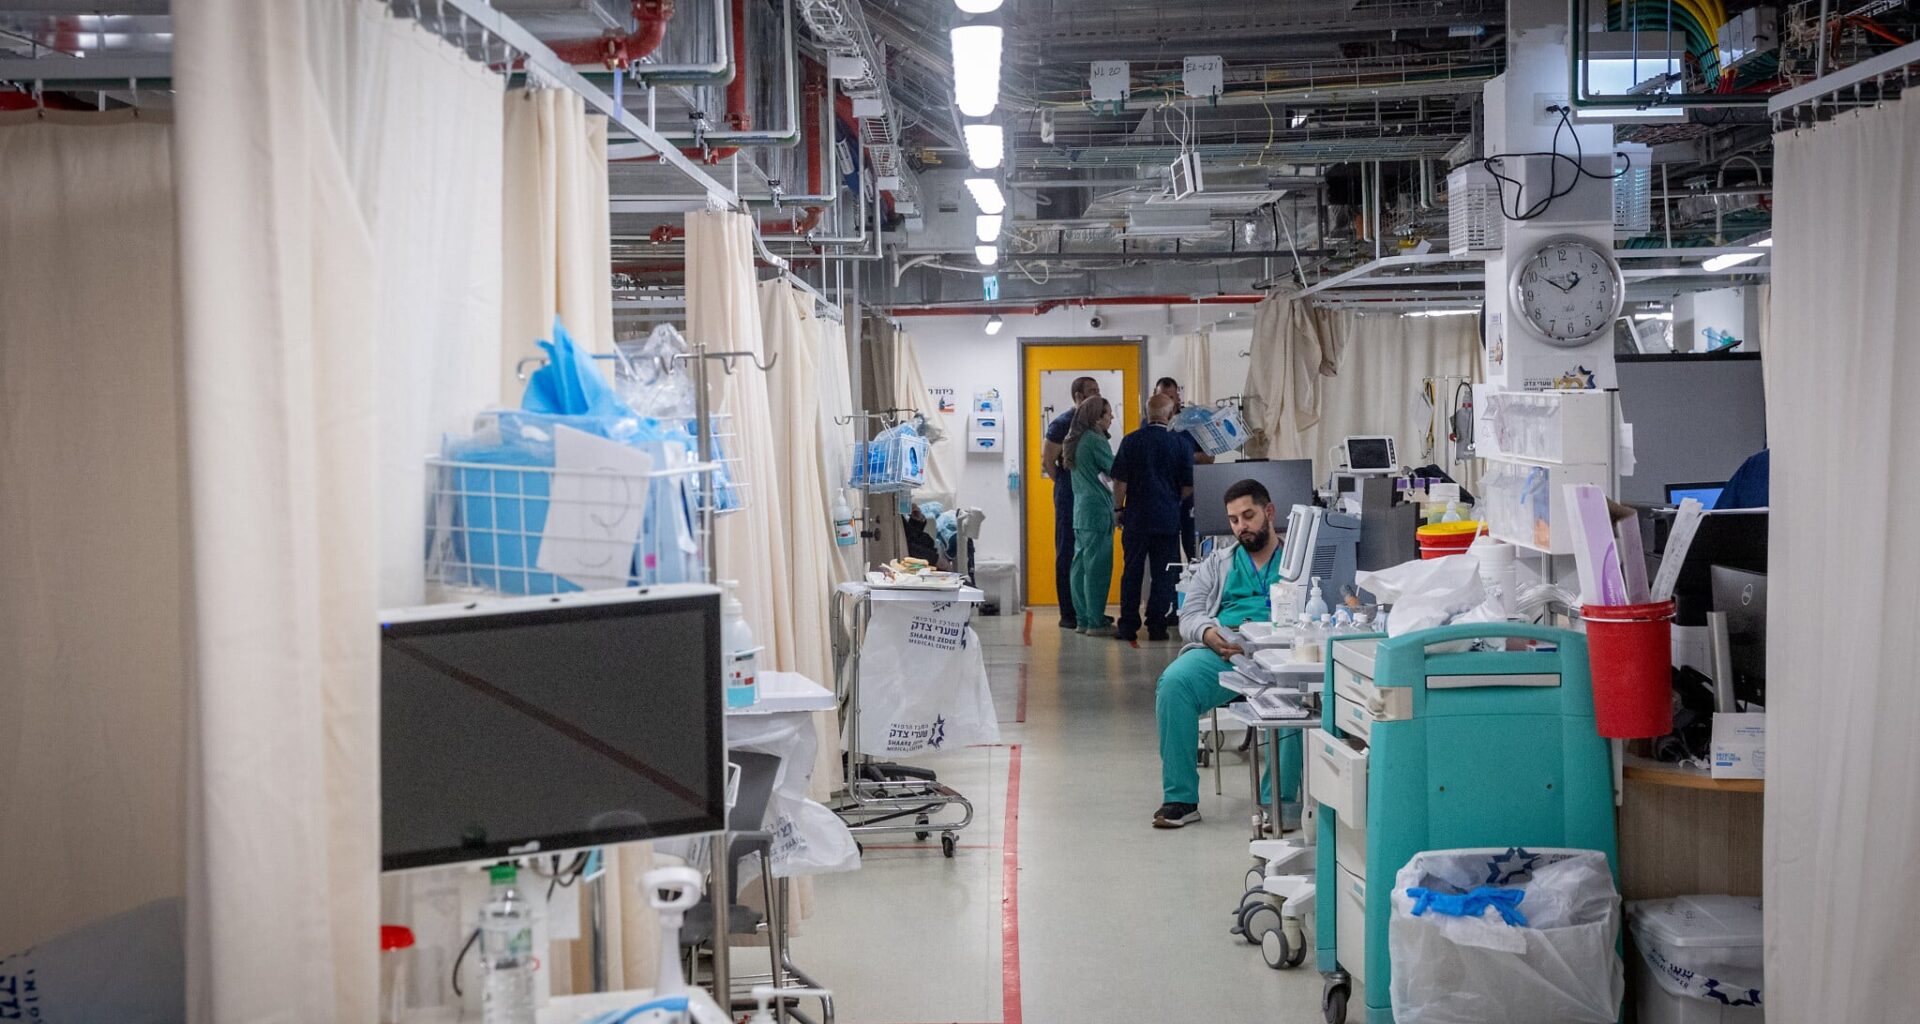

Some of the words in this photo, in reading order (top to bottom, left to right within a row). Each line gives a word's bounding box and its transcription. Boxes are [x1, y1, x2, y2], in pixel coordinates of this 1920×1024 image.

[1108, 67, 1120, 77] 20
[1557, 248, 1567, 261] 12
[1578, 251, 1583, 263] 1
[1540, 256, 1548, 268] 11
[1591, 262, 1598, 275] 2
[1528, 271, 1537, 283] 10
[1600, 280, 1606, 293] 3
[1527, 290, 1534, 302] 9
[1596, 300, 1603, 312] 4
[1534, 307, 1542, 320] 8
[1549, 319, 1556, 332] 7
[1567, 321, 1574, 334] 6
[1585, 315, 1591, 328] 5
[911, 621, 933, 632] צדק
[935, 625, 959, 637] שערי
[909, 631, 935, 642] SHAARE
[936, 636, 957, 645] ZEDEK
[908, 638, 934, 648] MEDICAL
[935, 642, 956, 651] CENTER
[889, 729, 909, 739] צדק
